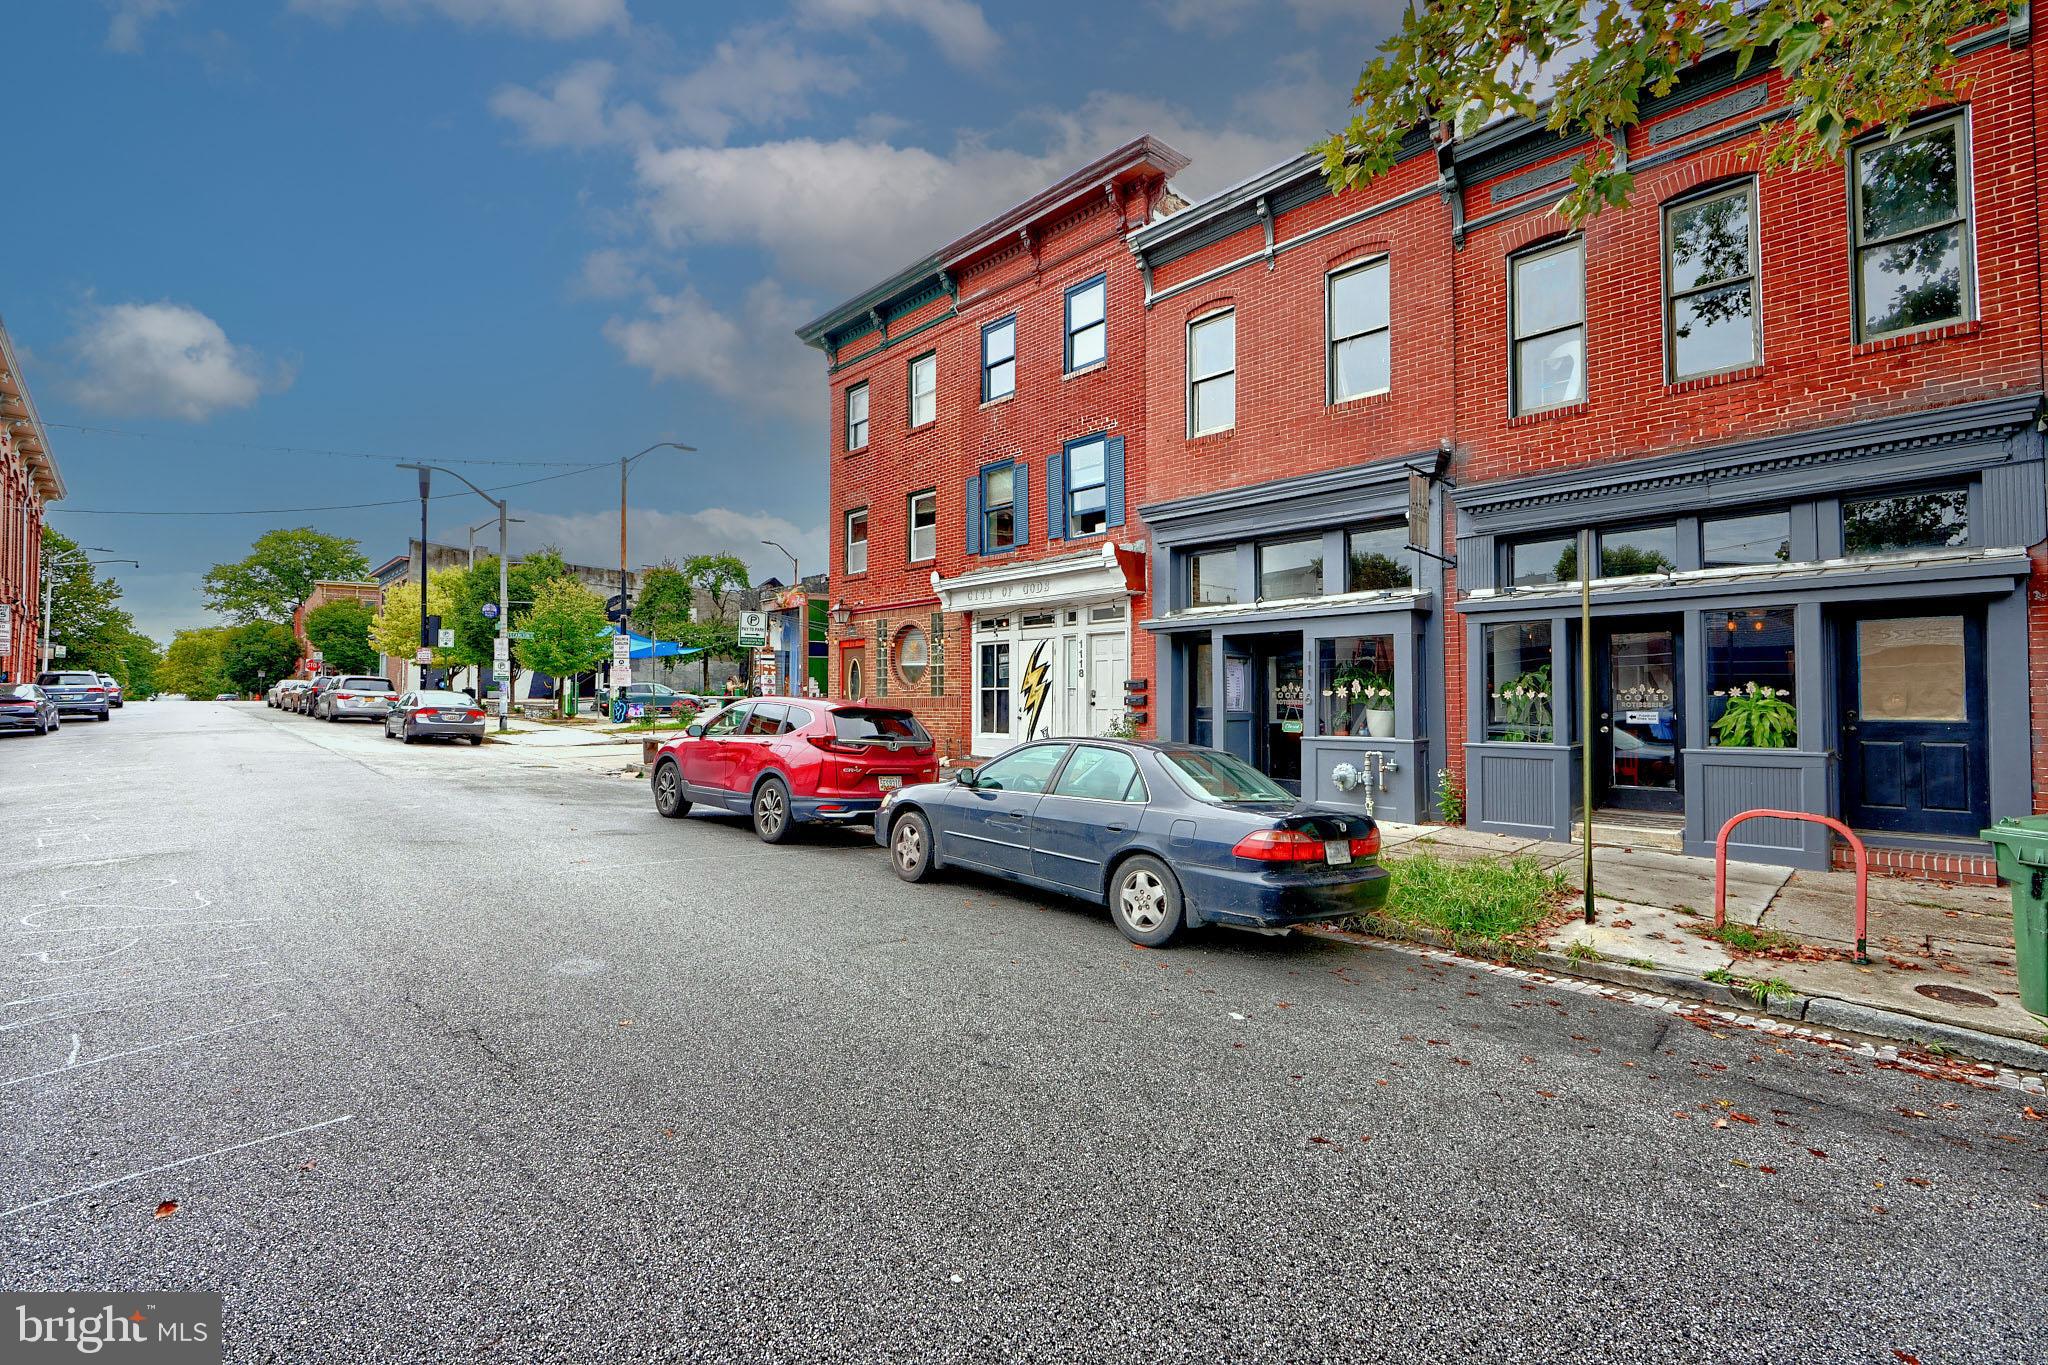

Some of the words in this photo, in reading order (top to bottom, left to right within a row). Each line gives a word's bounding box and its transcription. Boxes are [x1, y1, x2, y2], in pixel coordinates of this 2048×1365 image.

[967, 588, 993, 600] CITY
[1002, 586, 1014, 598] OF
[1023, 581, 1050, 594] GODS
